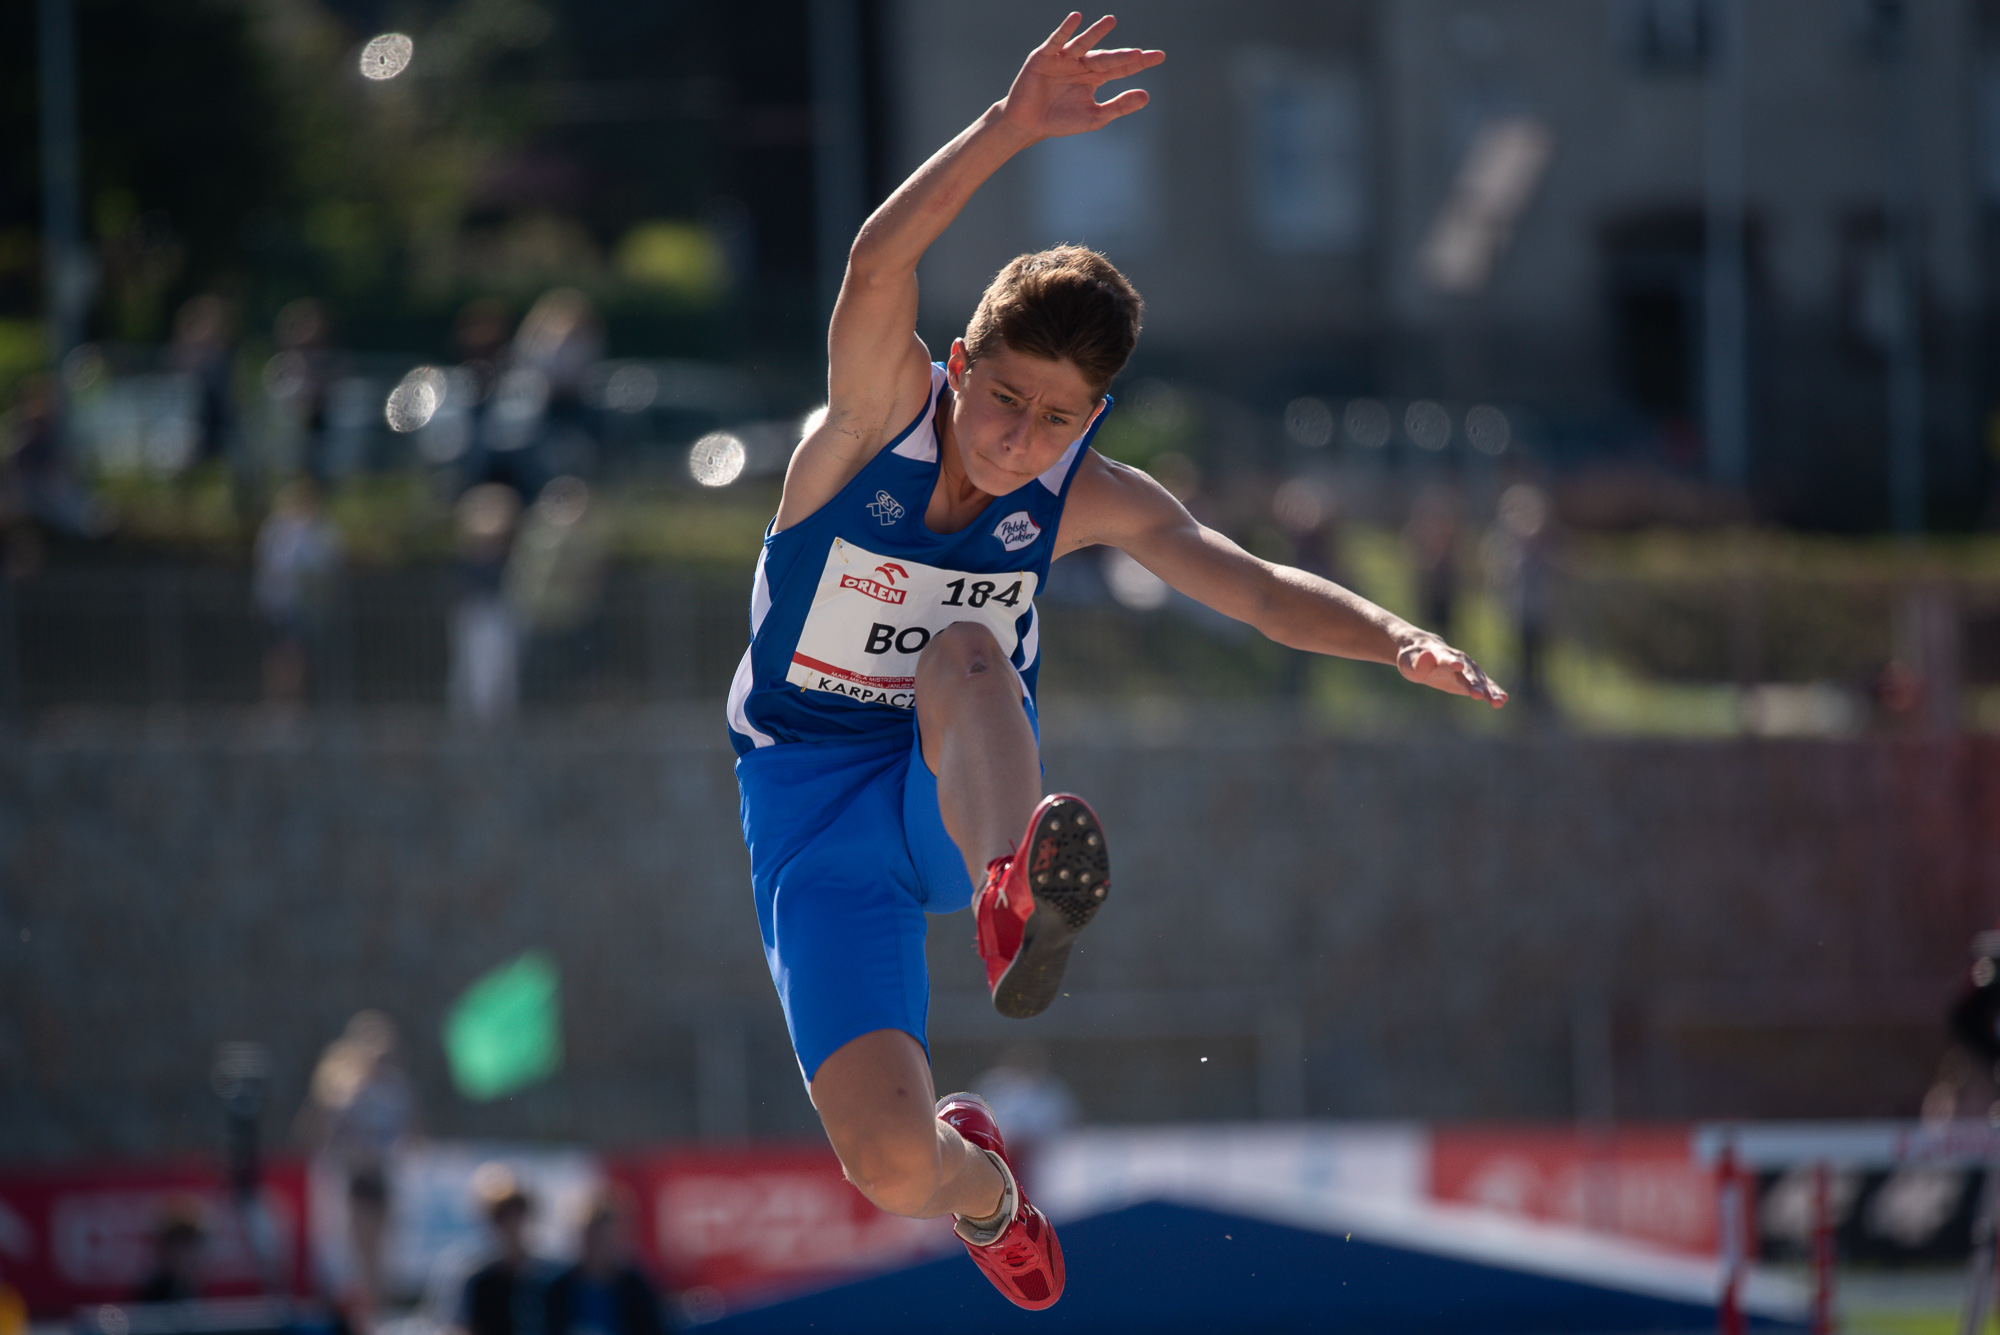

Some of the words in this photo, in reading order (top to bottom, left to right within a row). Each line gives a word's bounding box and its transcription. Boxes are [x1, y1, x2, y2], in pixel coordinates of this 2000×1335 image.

[1001, 519, 1029, 536] Polski
[1005, 530, 1036, 545] Cukier
[844, 578, 901, 603] ORLEN
[941, 578, 1022, 608] 184
[864, 621, 960, 655] BO
[818, 677, 915, 709] KARPACZ
